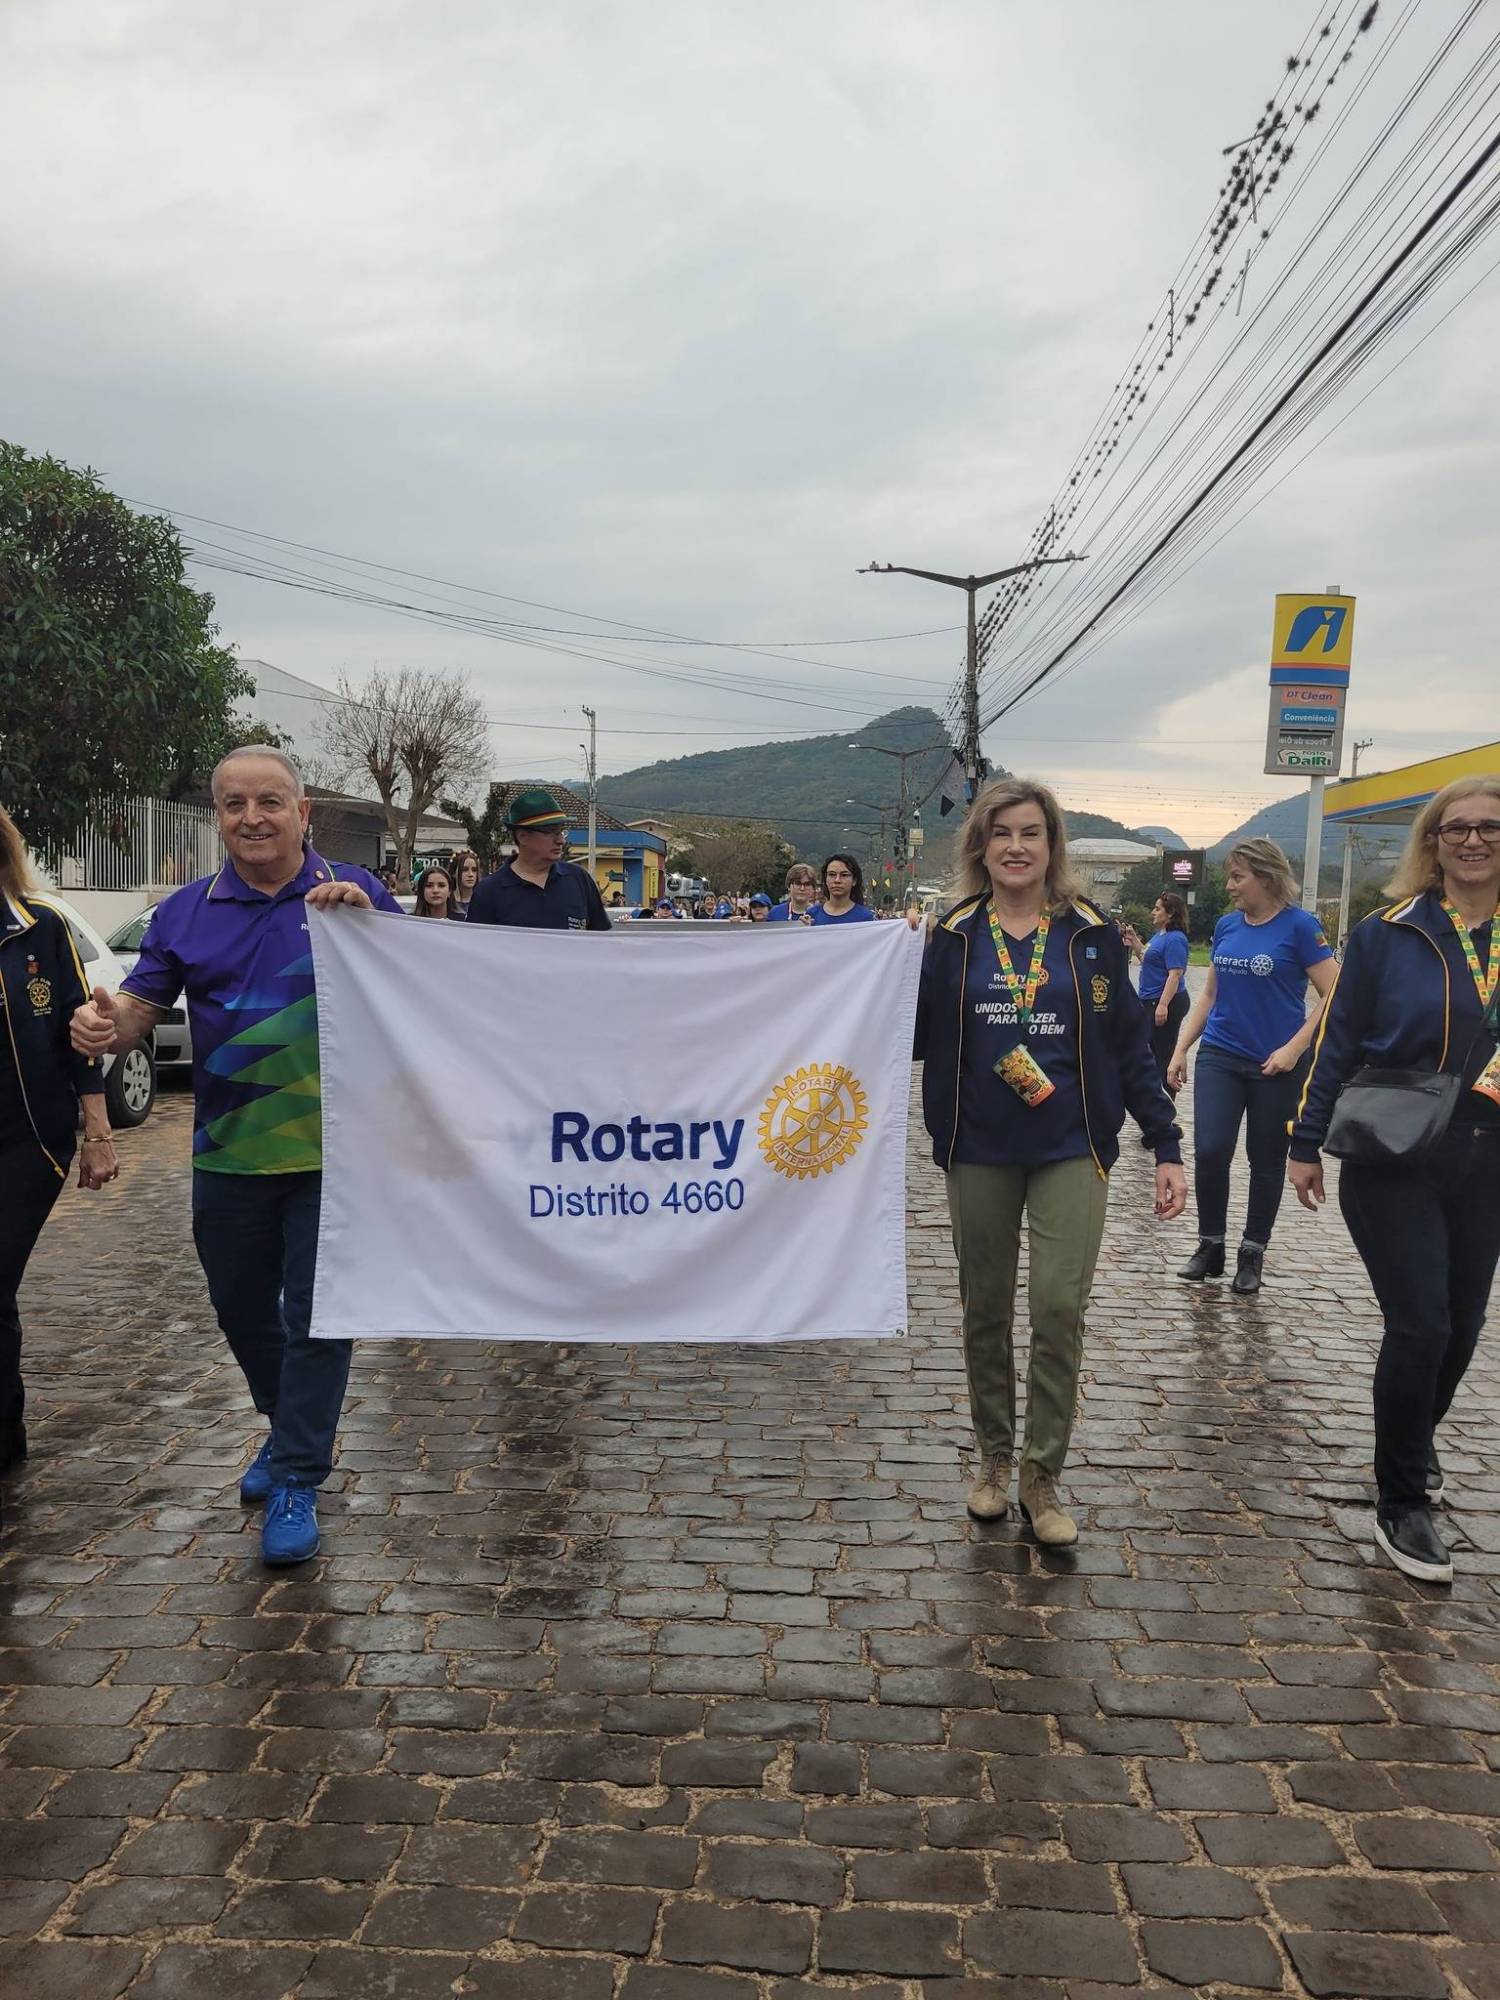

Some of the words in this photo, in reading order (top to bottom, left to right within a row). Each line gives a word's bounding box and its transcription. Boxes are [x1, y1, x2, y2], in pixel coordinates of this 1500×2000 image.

[1301, 691, 1333, 700] Clean
[975, 1003, 1017, 1014] UNIDOS
[987, 1014, 1018, 1025] PARA
[1028, 1024, 1038, 1035] O
[1040, 1024, 1066, 1035] BEM
[789, 1077, 841, 1098] ROTARY
[551, 1111, 744, 1170] Rotary
[775, 1127, 851, 1167] INTERNATIONAL
[529, 1183, 650, 1218] Distrito
[660, 1178, 745, 1215] 4660
